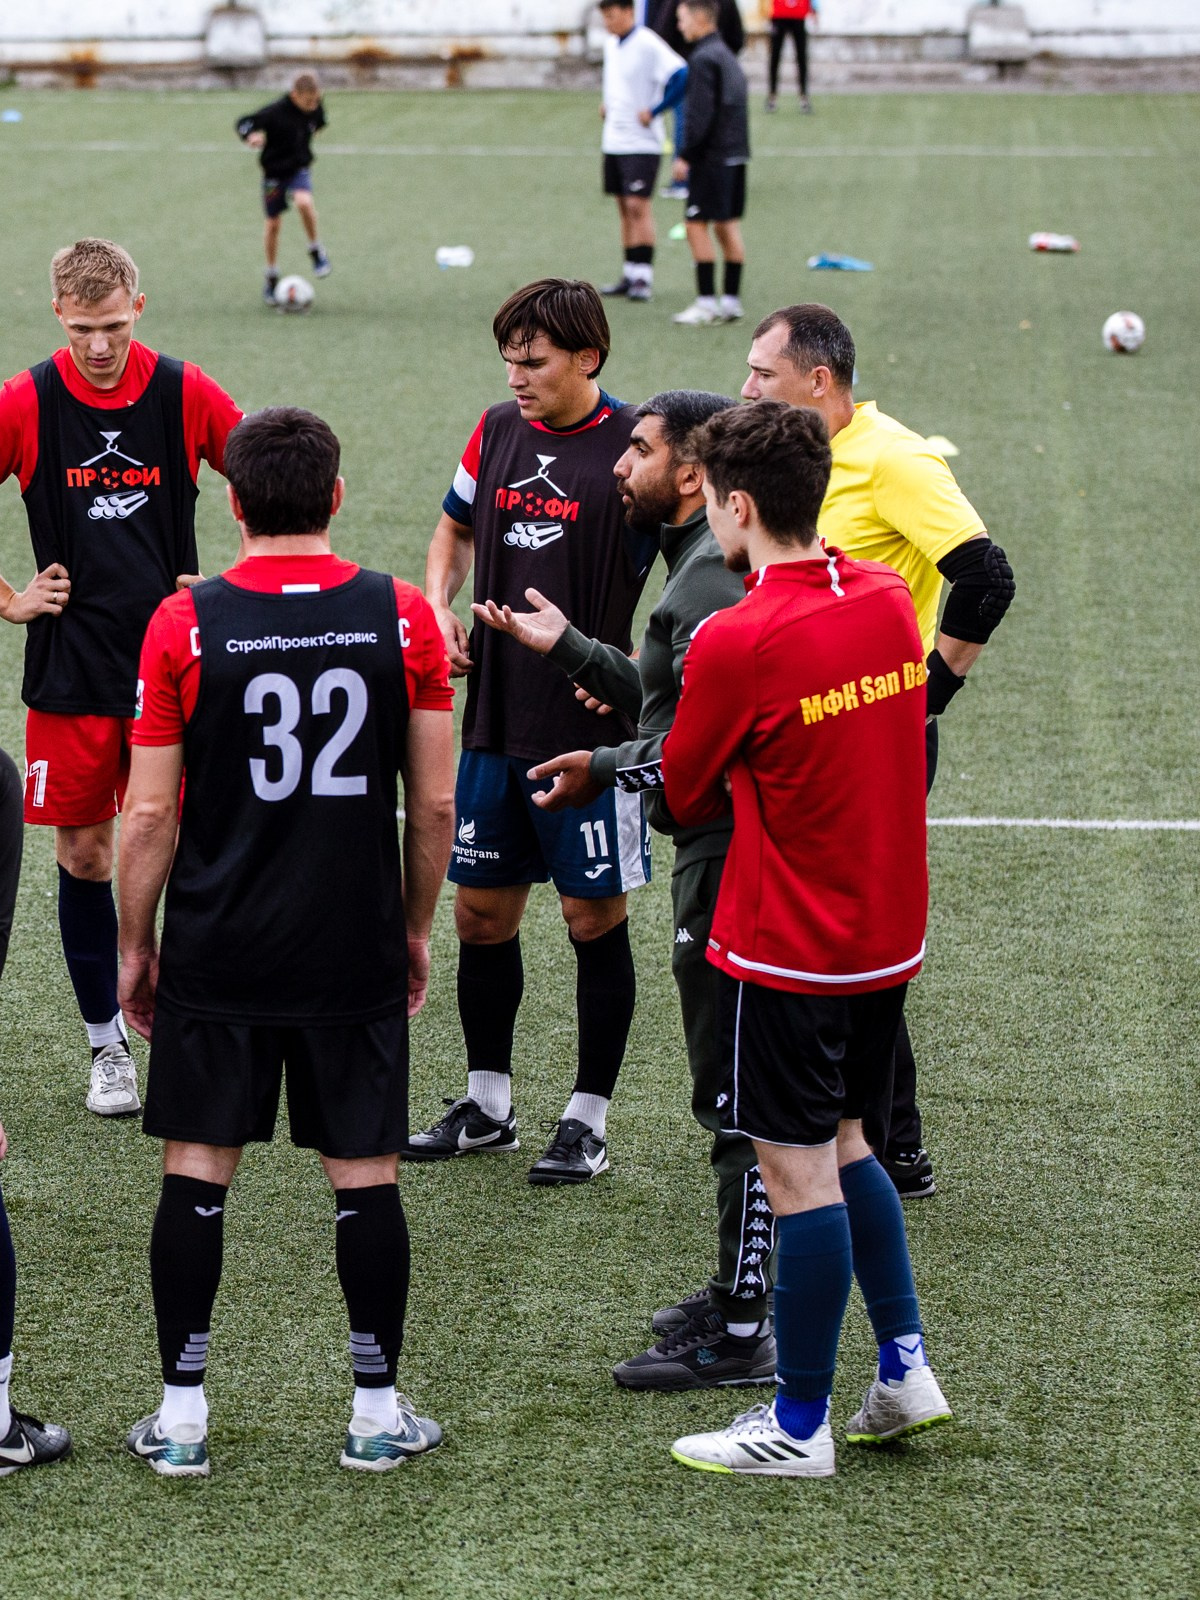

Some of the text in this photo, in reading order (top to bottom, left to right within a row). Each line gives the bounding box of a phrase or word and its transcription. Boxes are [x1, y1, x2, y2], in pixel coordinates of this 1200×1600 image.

[226, 631, 378, 654] СтройПроектСервис
[860, 671, 901, 705] San
[902, 655, 928, 691] Da
[244, 667, 369, 801] 32
[579, 819, 609, 859] 11
[456, 855, 477, 867] group
